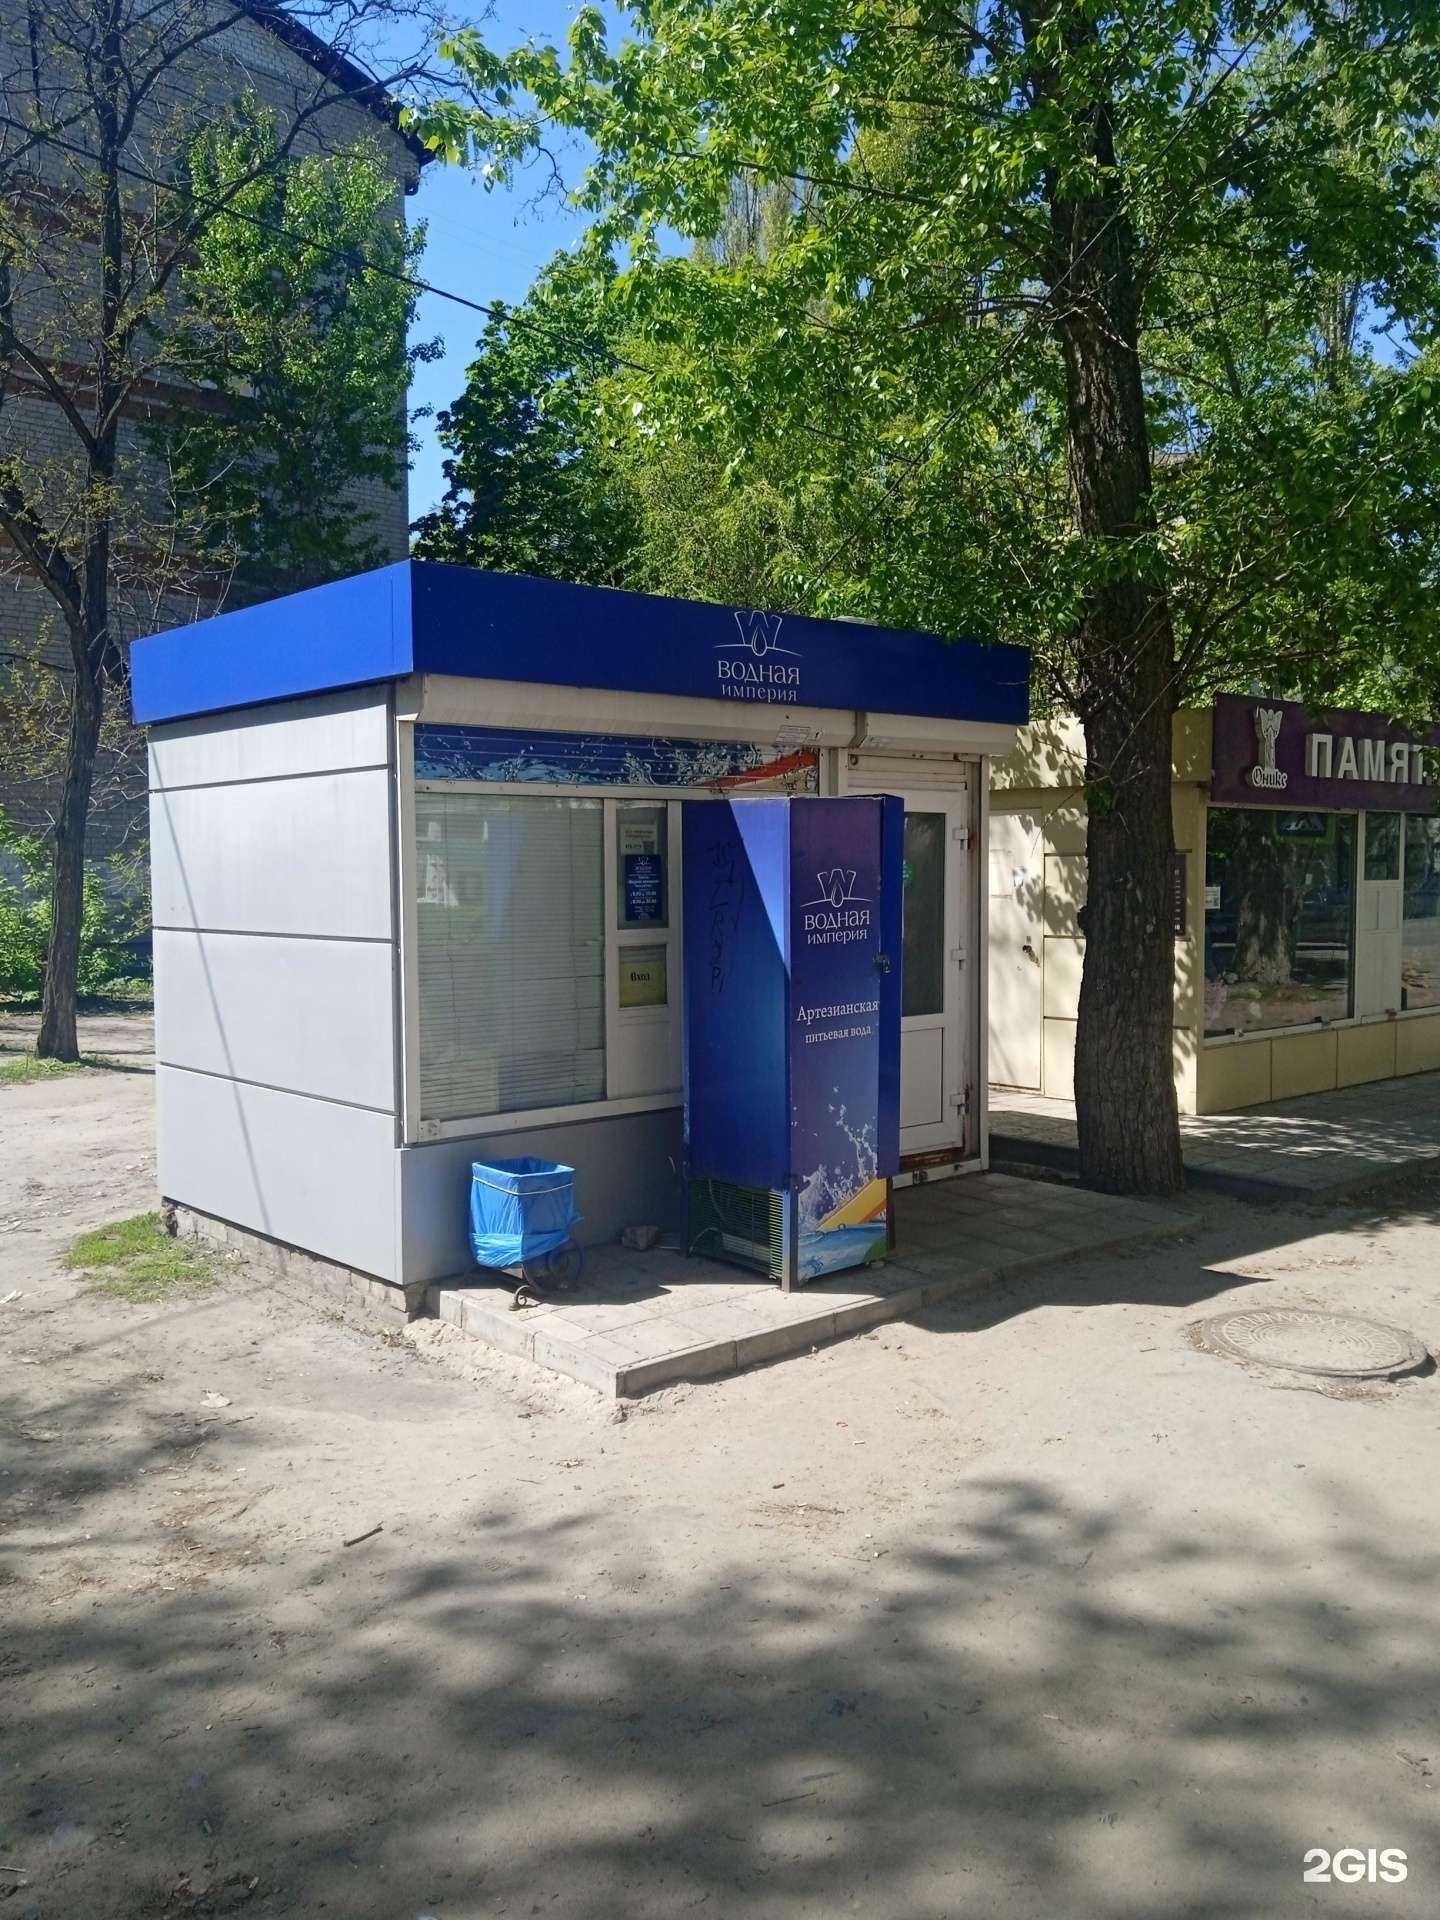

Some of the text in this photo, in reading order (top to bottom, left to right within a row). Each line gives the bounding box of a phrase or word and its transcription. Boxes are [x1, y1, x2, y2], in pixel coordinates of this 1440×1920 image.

[722, 684, 797, 703] империя
[1312, 733, 1439, 785] ПАМЯТ
[807, 929, 868, 945] империя
[796, 1000, 880, 1026] Артезианская
[805, 1025, 872, 1044] питьевая вода
